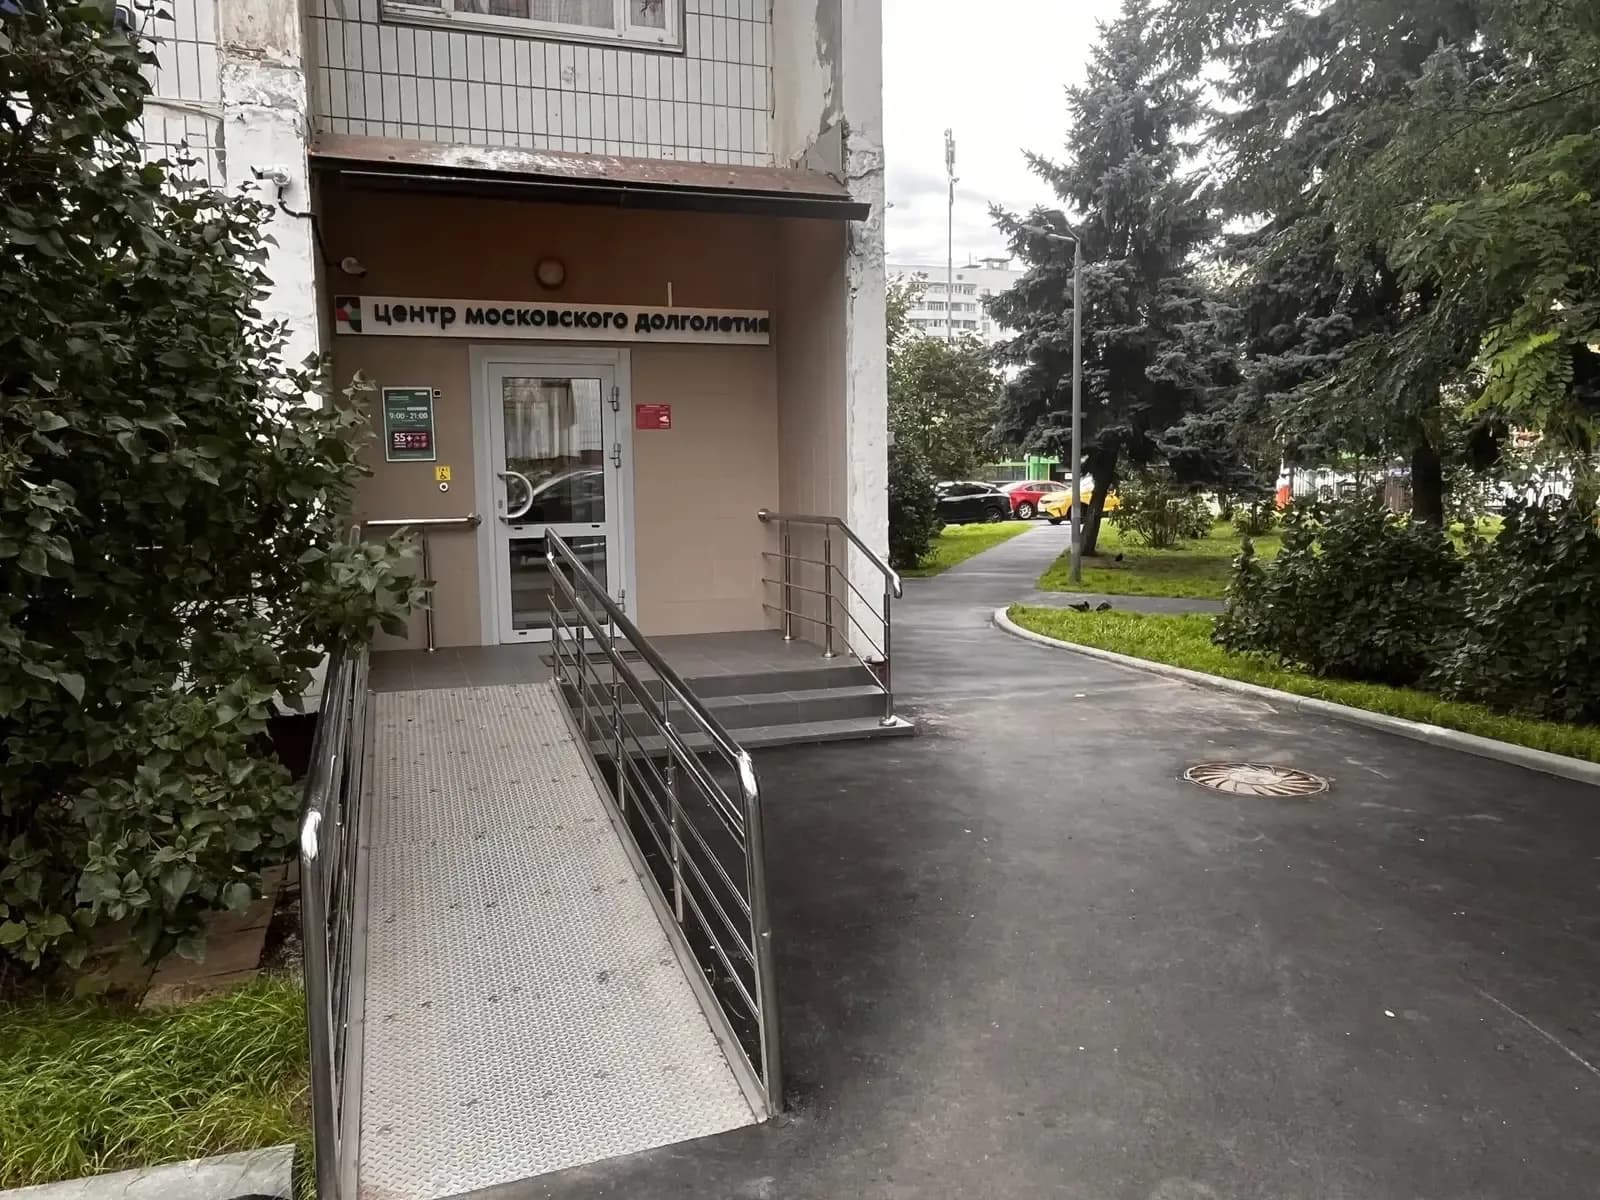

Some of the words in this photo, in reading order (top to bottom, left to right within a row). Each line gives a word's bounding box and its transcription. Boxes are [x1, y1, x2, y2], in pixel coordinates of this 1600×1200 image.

[465, 307, 628, 329] московского
[389, 412, 405, 420] 9:00
[410, 412, 428, 420] 21:00
